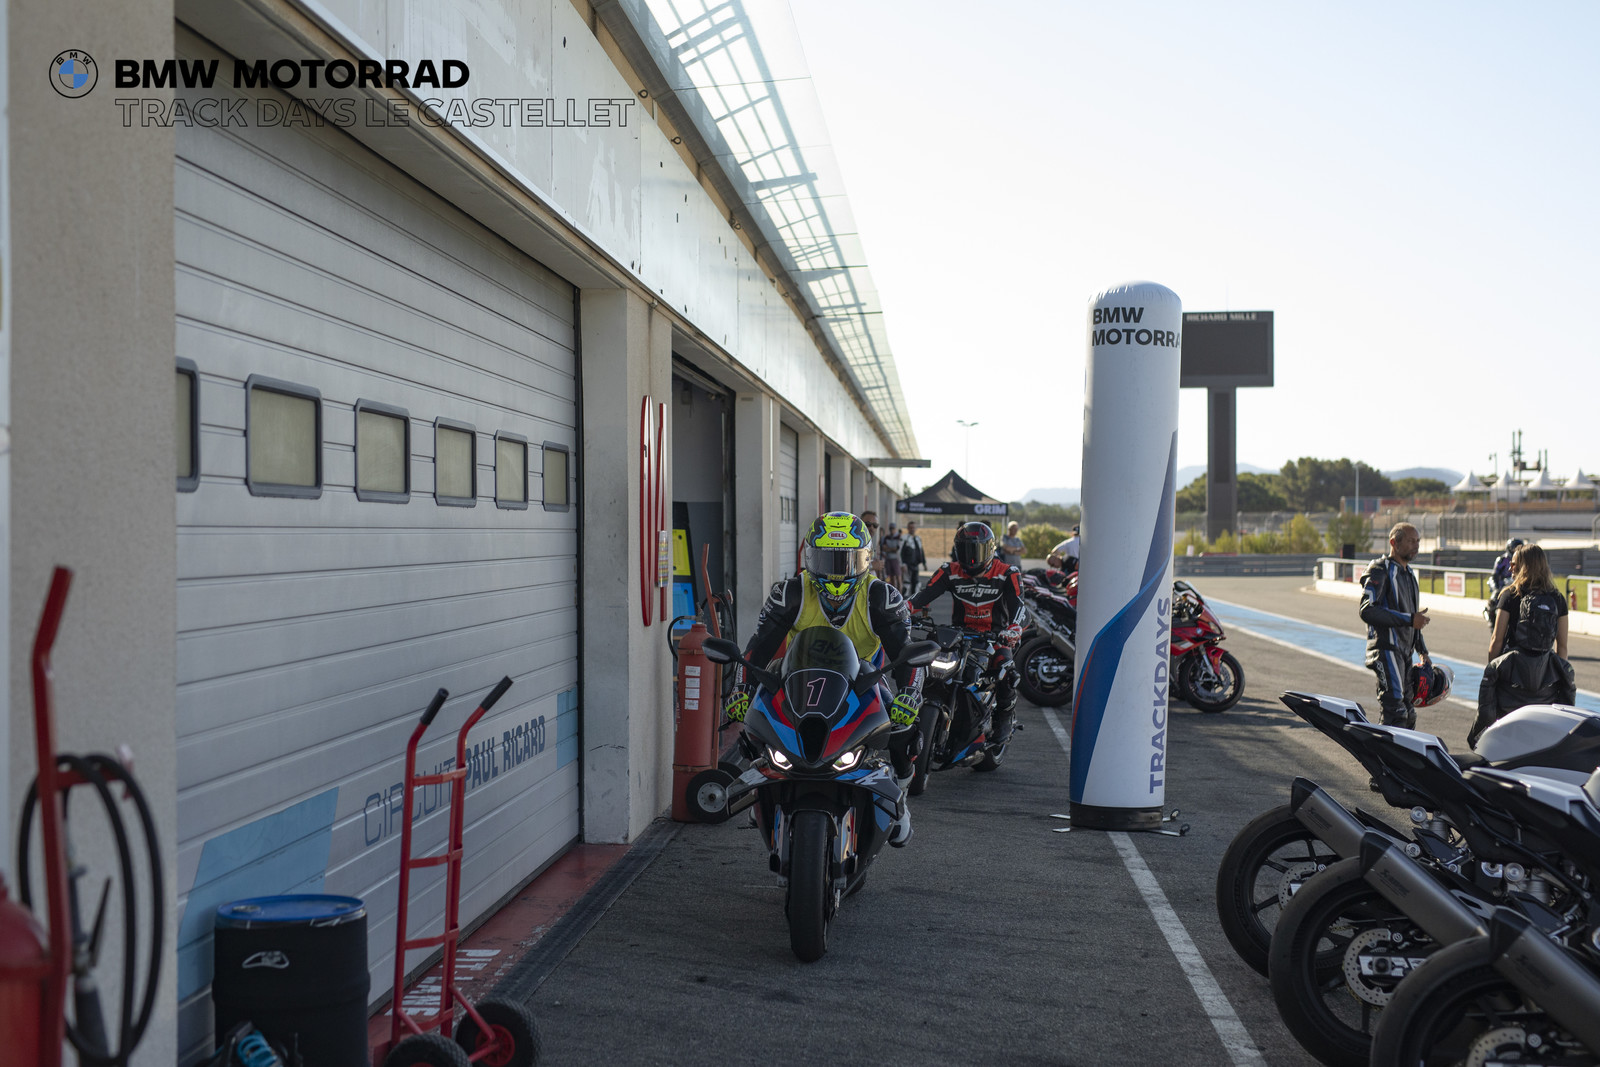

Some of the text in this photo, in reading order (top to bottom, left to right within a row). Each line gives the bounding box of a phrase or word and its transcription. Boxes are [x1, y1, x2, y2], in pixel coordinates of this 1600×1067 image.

[1092, 307, 1144, 325] BMW
[974, 504, 1006, 514] GRIM
[807, 677, 827, 706] 1
[1150, 597, 1171, 794] TRACKDAYS
[464, 737, 499, 792] PAUL
[502, 714, 546, 773] RICARD
